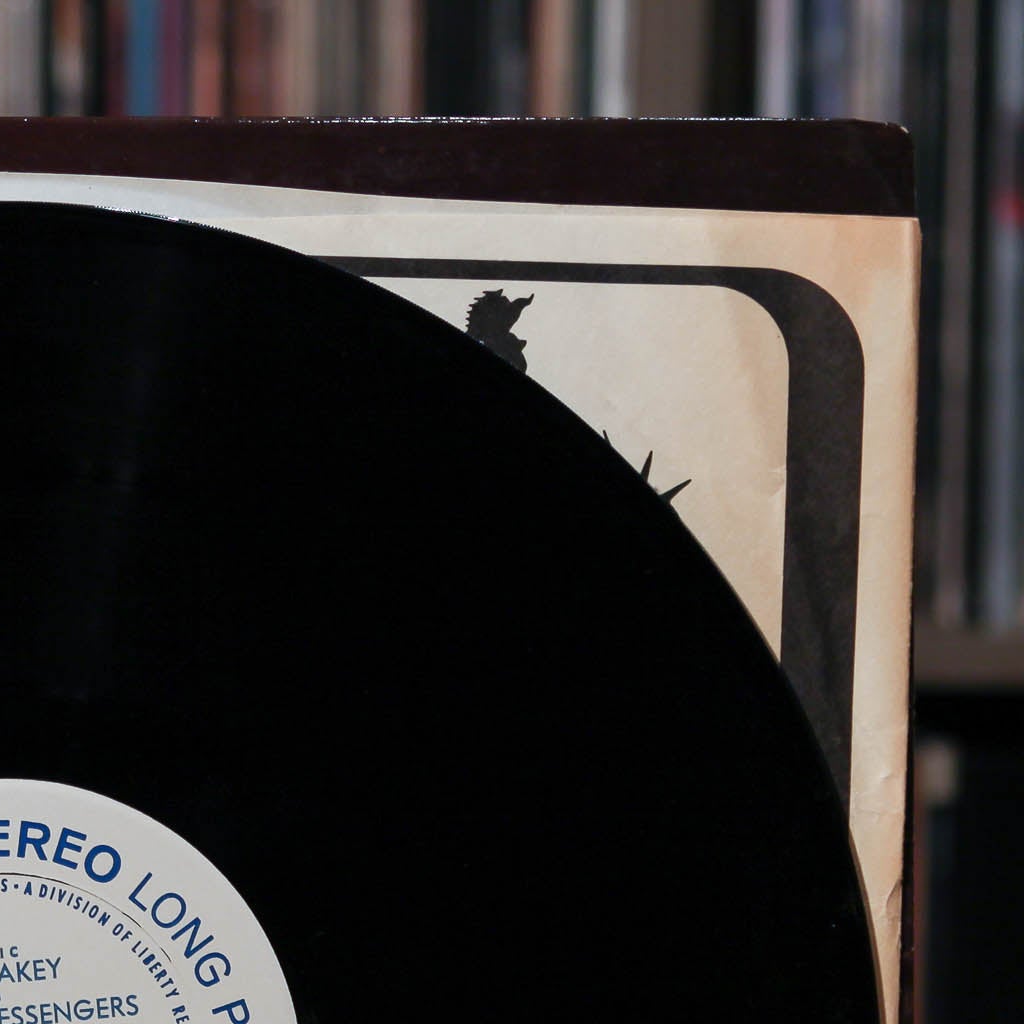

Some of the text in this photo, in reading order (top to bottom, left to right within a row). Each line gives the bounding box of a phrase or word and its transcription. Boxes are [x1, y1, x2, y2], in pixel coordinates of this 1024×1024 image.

[23, 881, 33, 896] A
[38, 883, 112, 927] DIVISION
[112, 922, 134, 942] OF
[131, 940, 180, 998] LIBERTY
[128, 872, 232, 988] LONG
